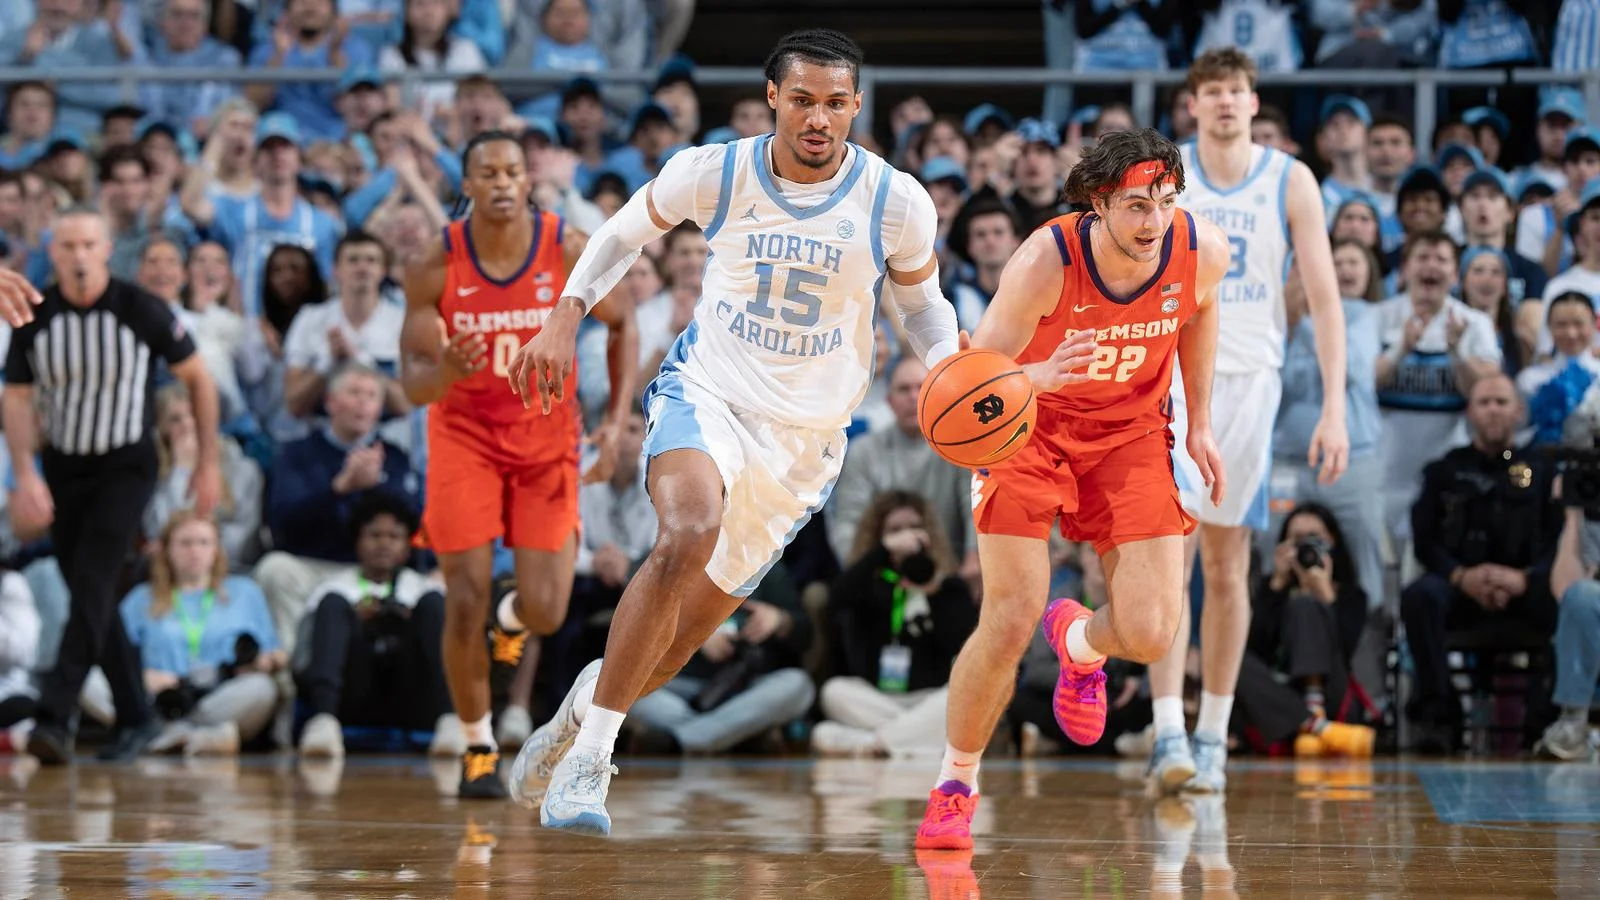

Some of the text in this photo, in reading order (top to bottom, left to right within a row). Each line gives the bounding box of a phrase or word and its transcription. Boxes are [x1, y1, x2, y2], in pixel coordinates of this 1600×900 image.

[1195, 207, 1256, 233] ORTH
[746, 233, 843, 273] NORTH
[746, 261, 829, 327] 15
[1221, 283, 1267, 303] LINA
[716, 300, 843, 356] CAROLINA
[1064, 317, 1179, 342] CEMSON
[492, 333, 520, 377] 0
[1087, 345, 1147, 382] 22
